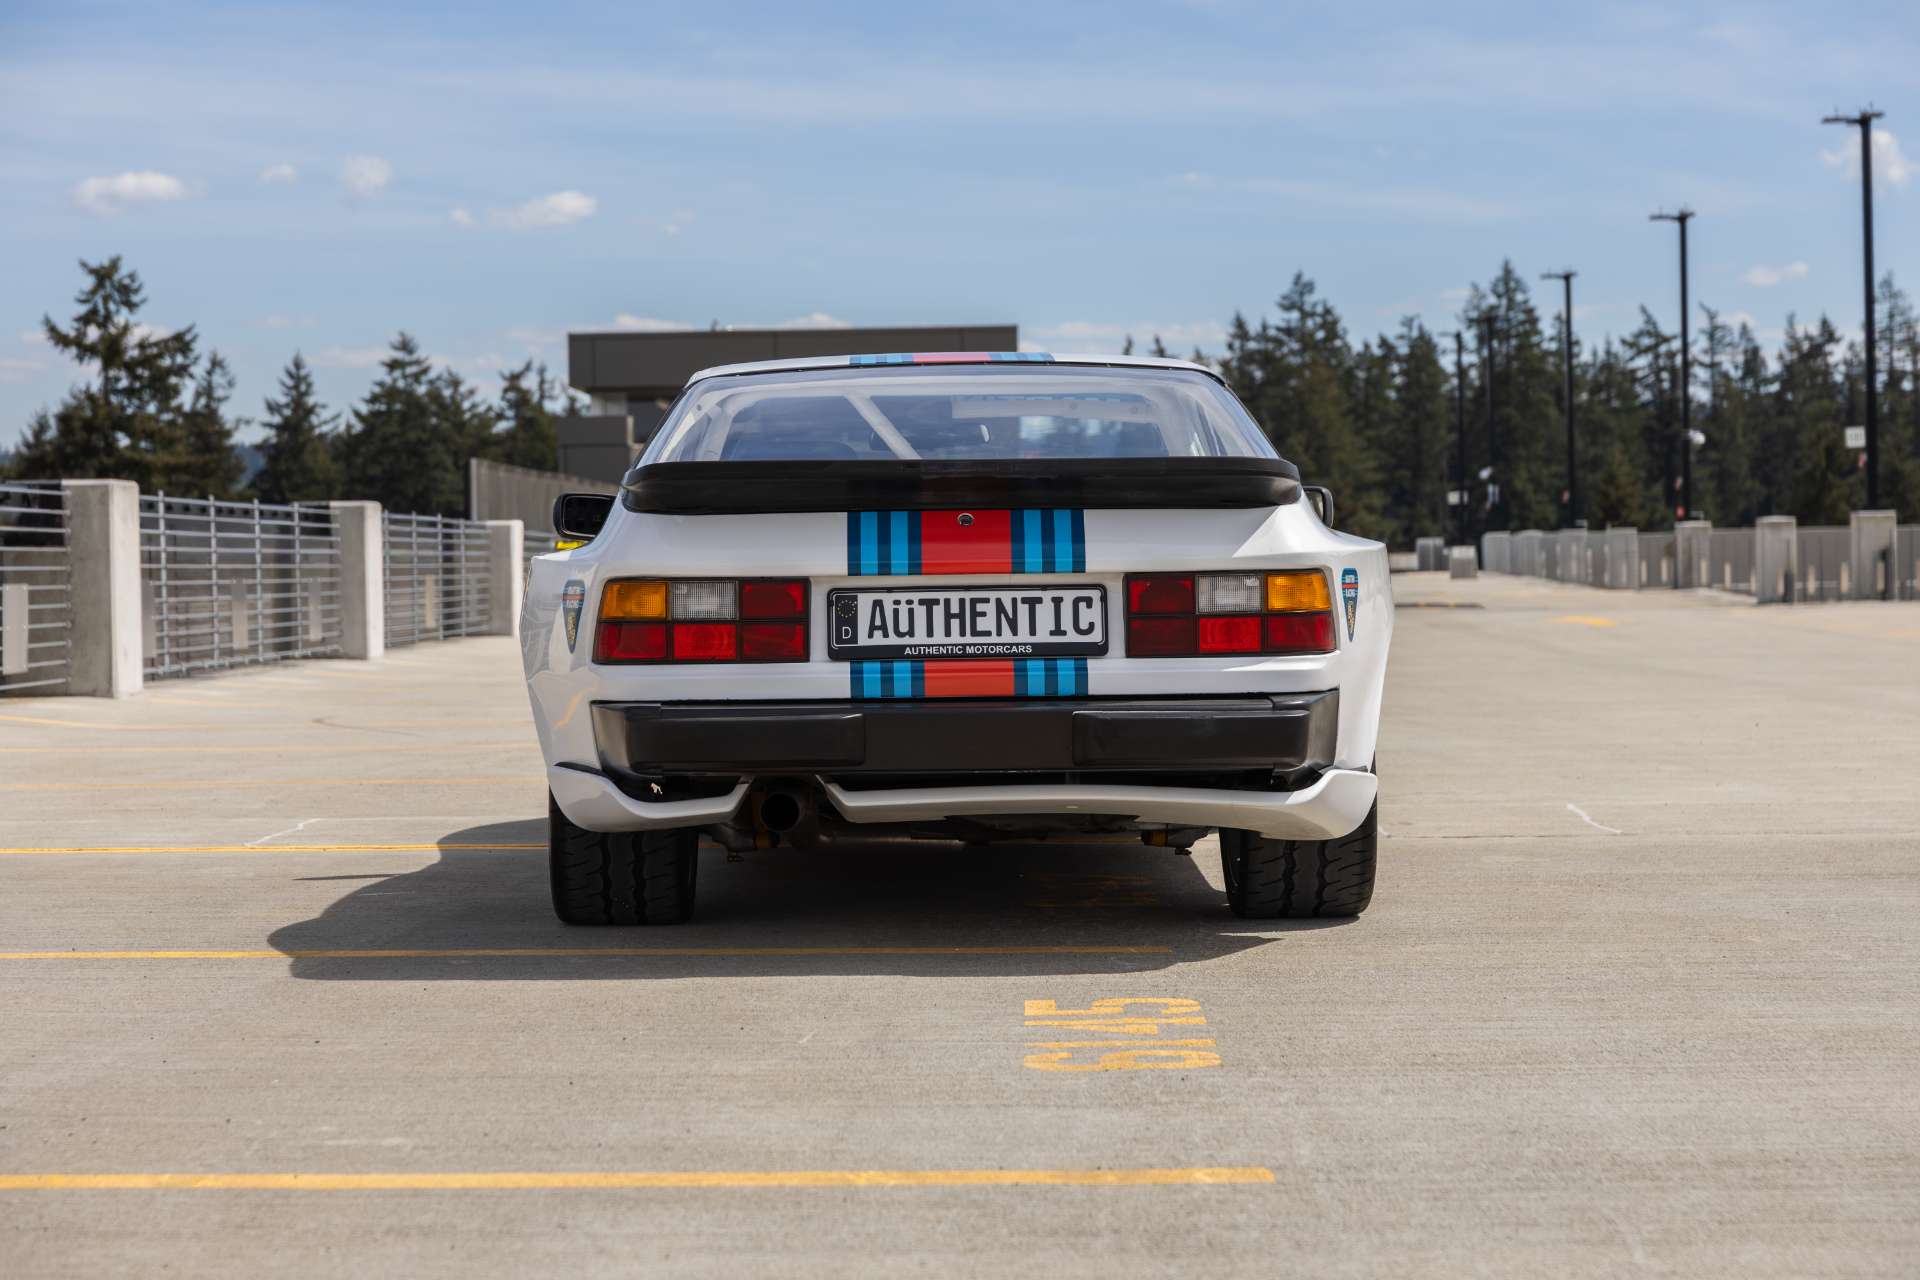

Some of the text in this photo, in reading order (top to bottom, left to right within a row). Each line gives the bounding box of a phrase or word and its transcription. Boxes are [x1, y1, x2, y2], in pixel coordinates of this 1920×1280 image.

[842, 626, 852, 639] D
[904, 645, 1033, 655] AUTHENTIC MOTORCARS
[1024, 997, 1222, 1072] 6145
